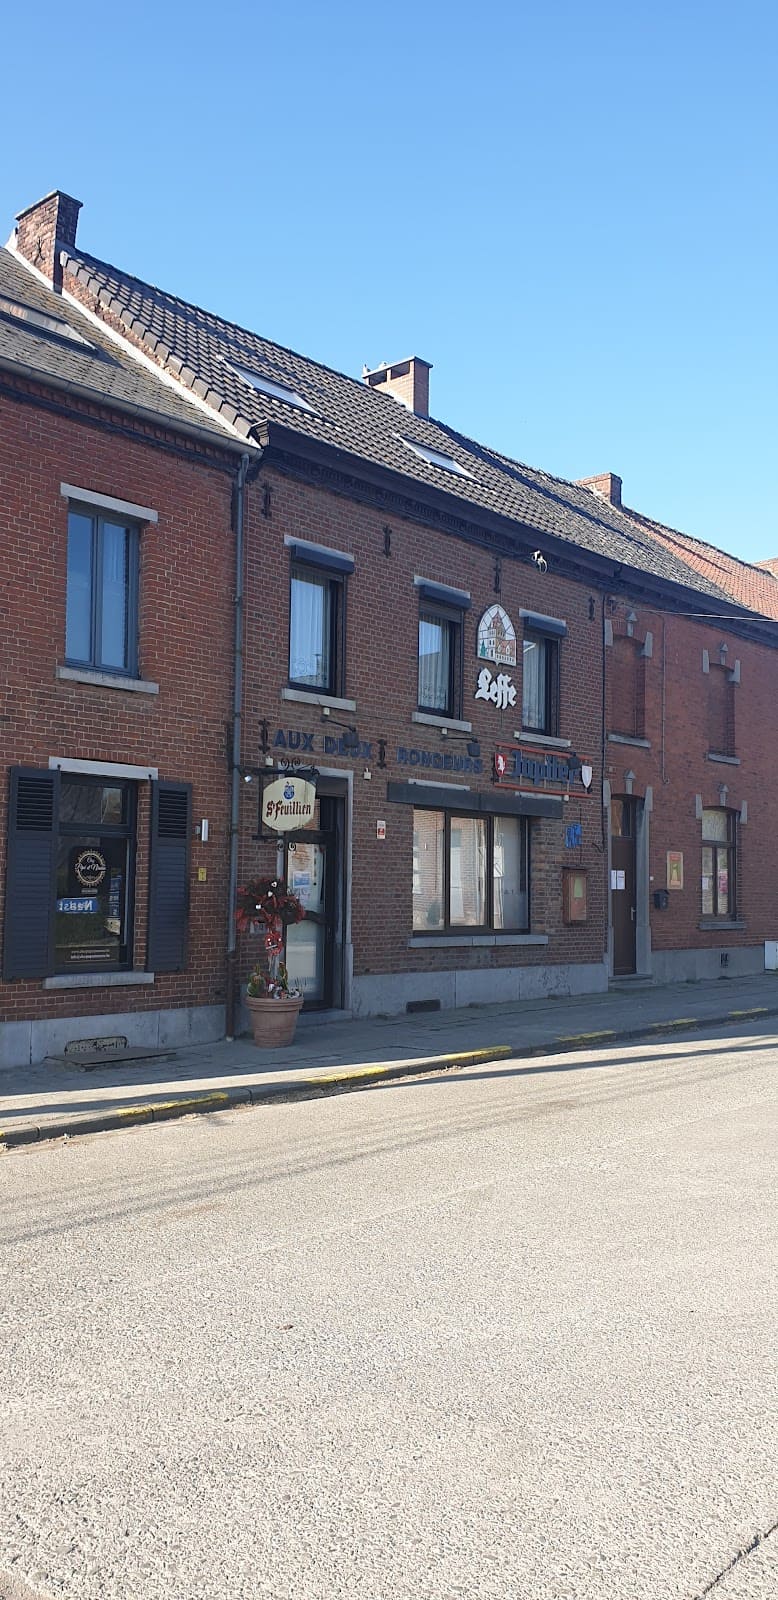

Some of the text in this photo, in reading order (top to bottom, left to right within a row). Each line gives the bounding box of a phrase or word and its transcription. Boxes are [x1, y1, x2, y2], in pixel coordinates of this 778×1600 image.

[475, 667, 517, 710] Leffe
[272, 728, 316, 752] AUX
[396, 746, 484, 774] RONGEURS
